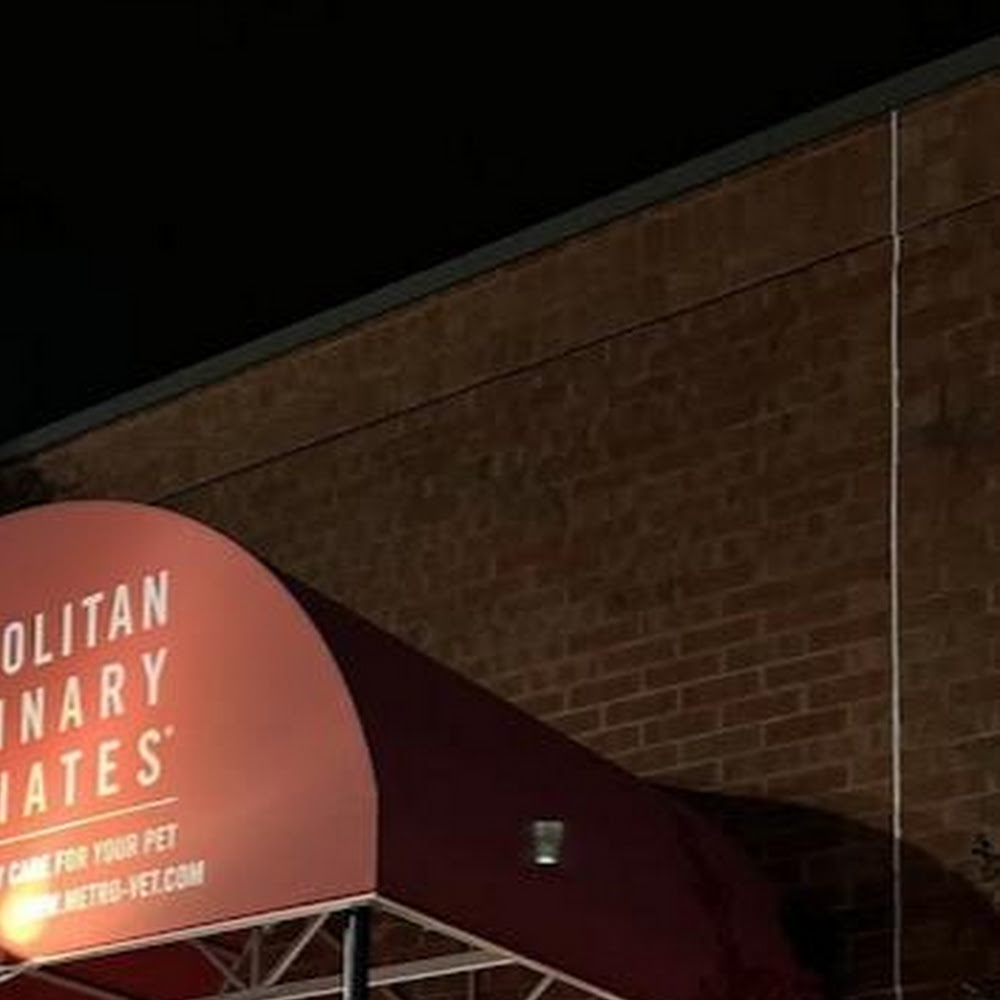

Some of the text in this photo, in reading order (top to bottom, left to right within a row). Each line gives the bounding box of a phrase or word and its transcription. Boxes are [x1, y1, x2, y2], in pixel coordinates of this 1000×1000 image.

[54, 845, 89, 873] FOR
[93, 833, 138, 864] YOUR
[143, 823, 179, 855] PET
